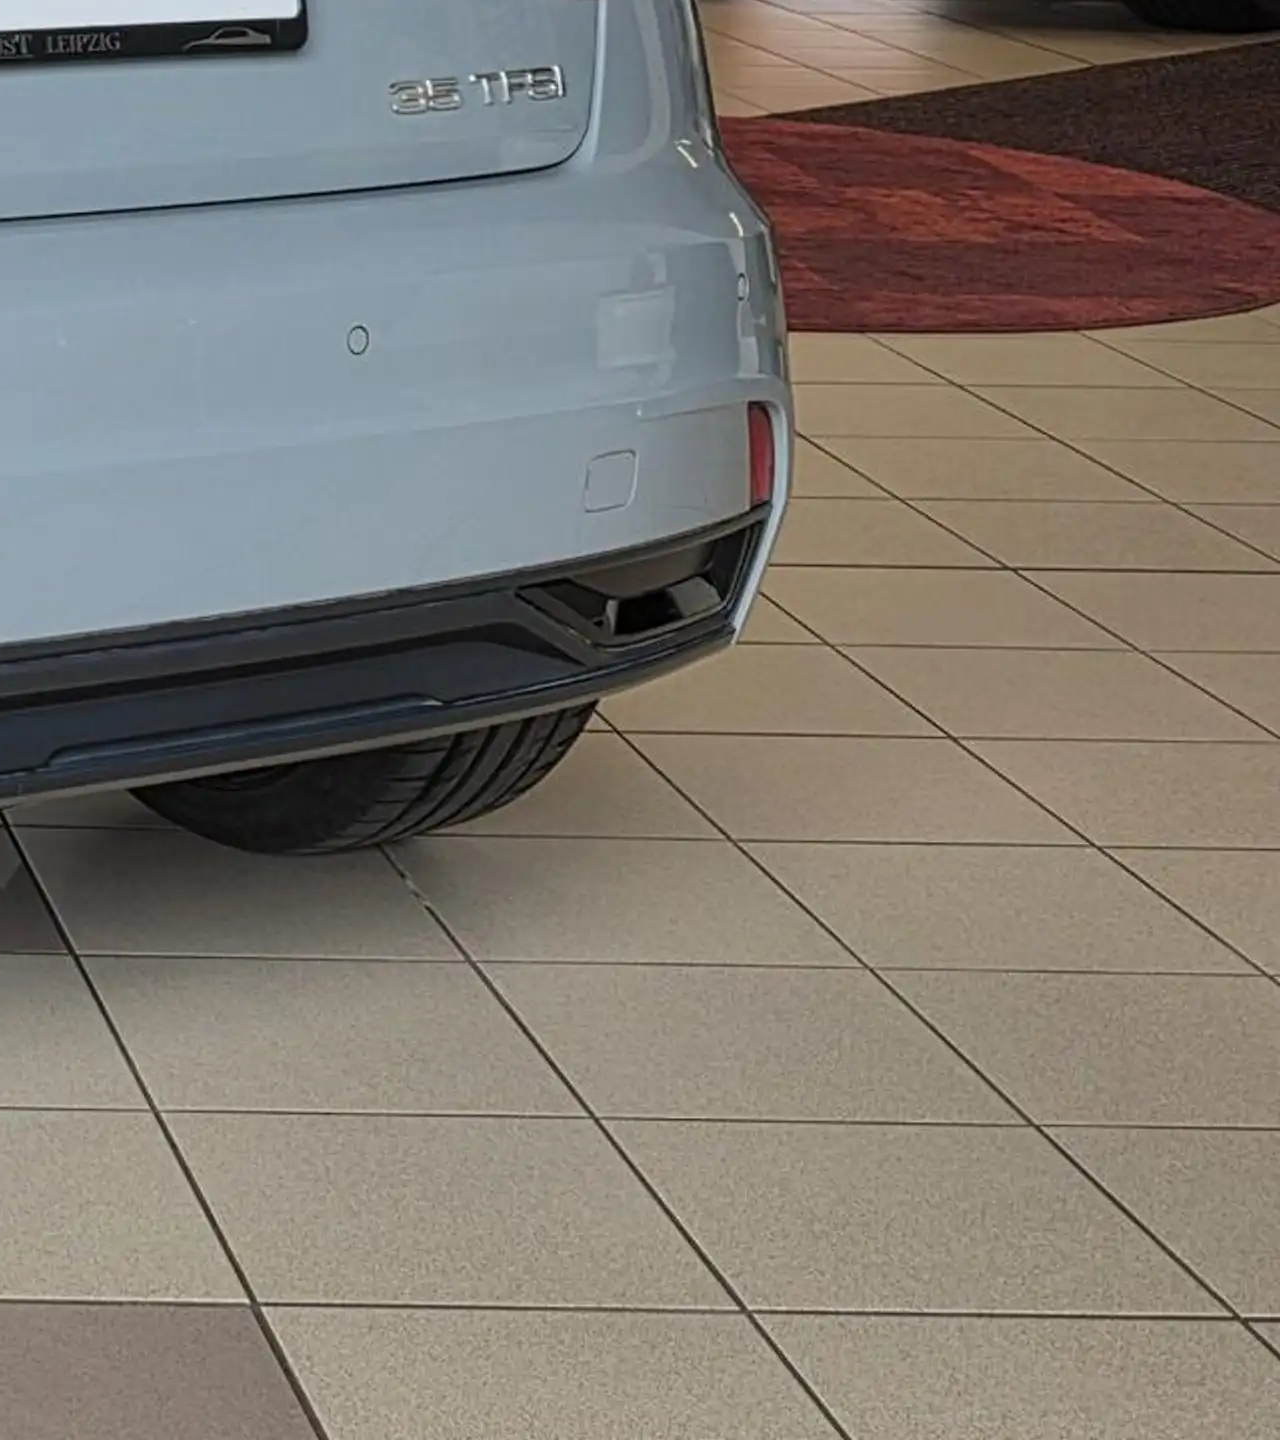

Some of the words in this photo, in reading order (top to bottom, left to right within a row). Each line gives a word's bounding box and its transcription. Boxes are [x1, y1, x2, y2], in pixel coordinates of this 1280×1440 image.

[45, 32, 122, 55] LEIPZIG
[388, 76, 464, 116] 35
[466, 64, 567, 107] TFSI
